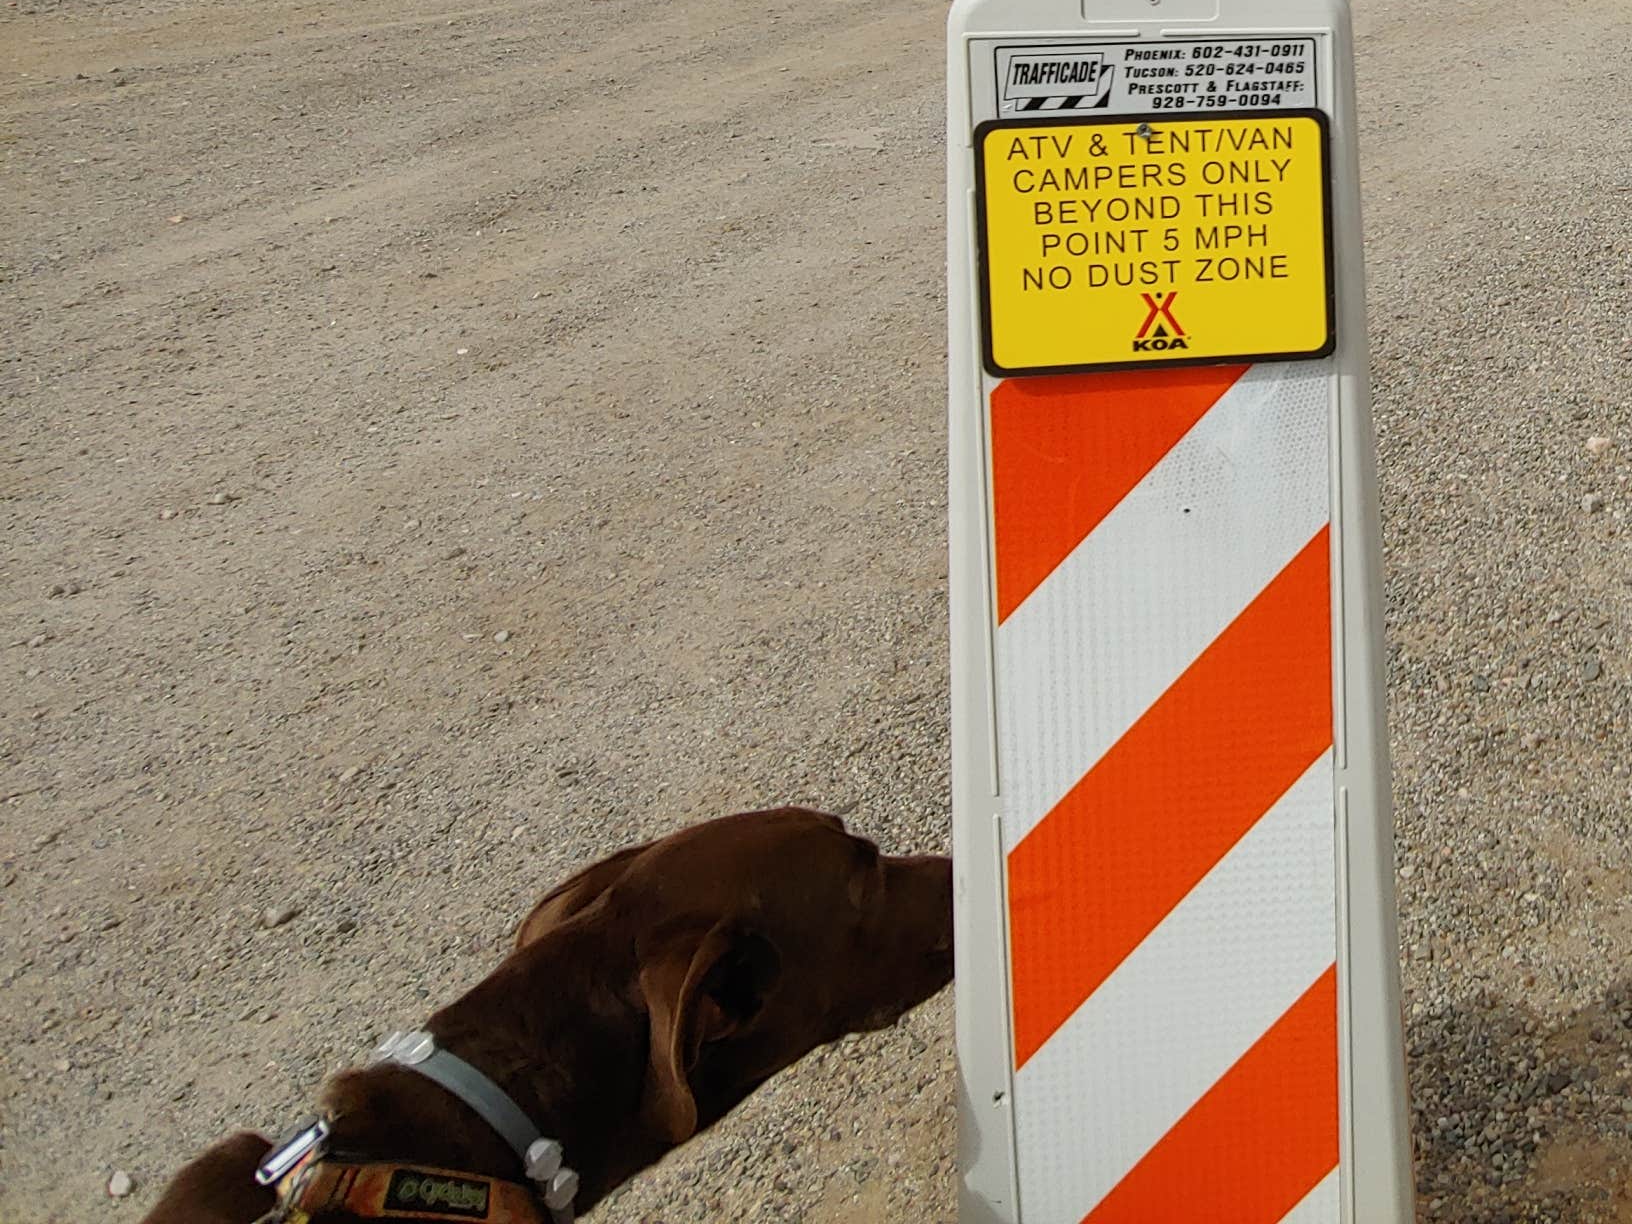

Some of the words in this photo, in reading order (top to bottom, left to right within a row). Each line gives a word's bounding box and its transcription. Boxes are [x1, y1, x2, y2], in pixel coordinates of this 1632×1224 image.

[1192, 44, 1305, 59] 602-431-0911
[1012, 60, 1098, 85] TRAFFICADE
[1184, 62, 1305, 76] 520-624-0465
[1206, 82, 1217, 93] &
[1152, 94, 1281, 109] 928-759-0094
[1007, 135, 1074, 161] ATV
[1089, 133, 1109, 157] &
[1122, 126, 1294, 156] TENT/VAN
[1013, 163, 1186, 193] CAMPERS
[1202, 159, 1291, 184] ONLY
[1034, 195, 1181, 225] BEYOND
[1195, 192, 1273, 218] THIS
[1042, 229, 1149, 258] POINT
[1163, 229, 1179, 251] 5
[1196, 224, 1268, 250] MPH
[1022, 266, 1072, 291] NO
[1088, 261, 1181, 287] DUST
[1195, 255, 1289, 282] ZONE
[1132, 338, 1188, 351] KOA
